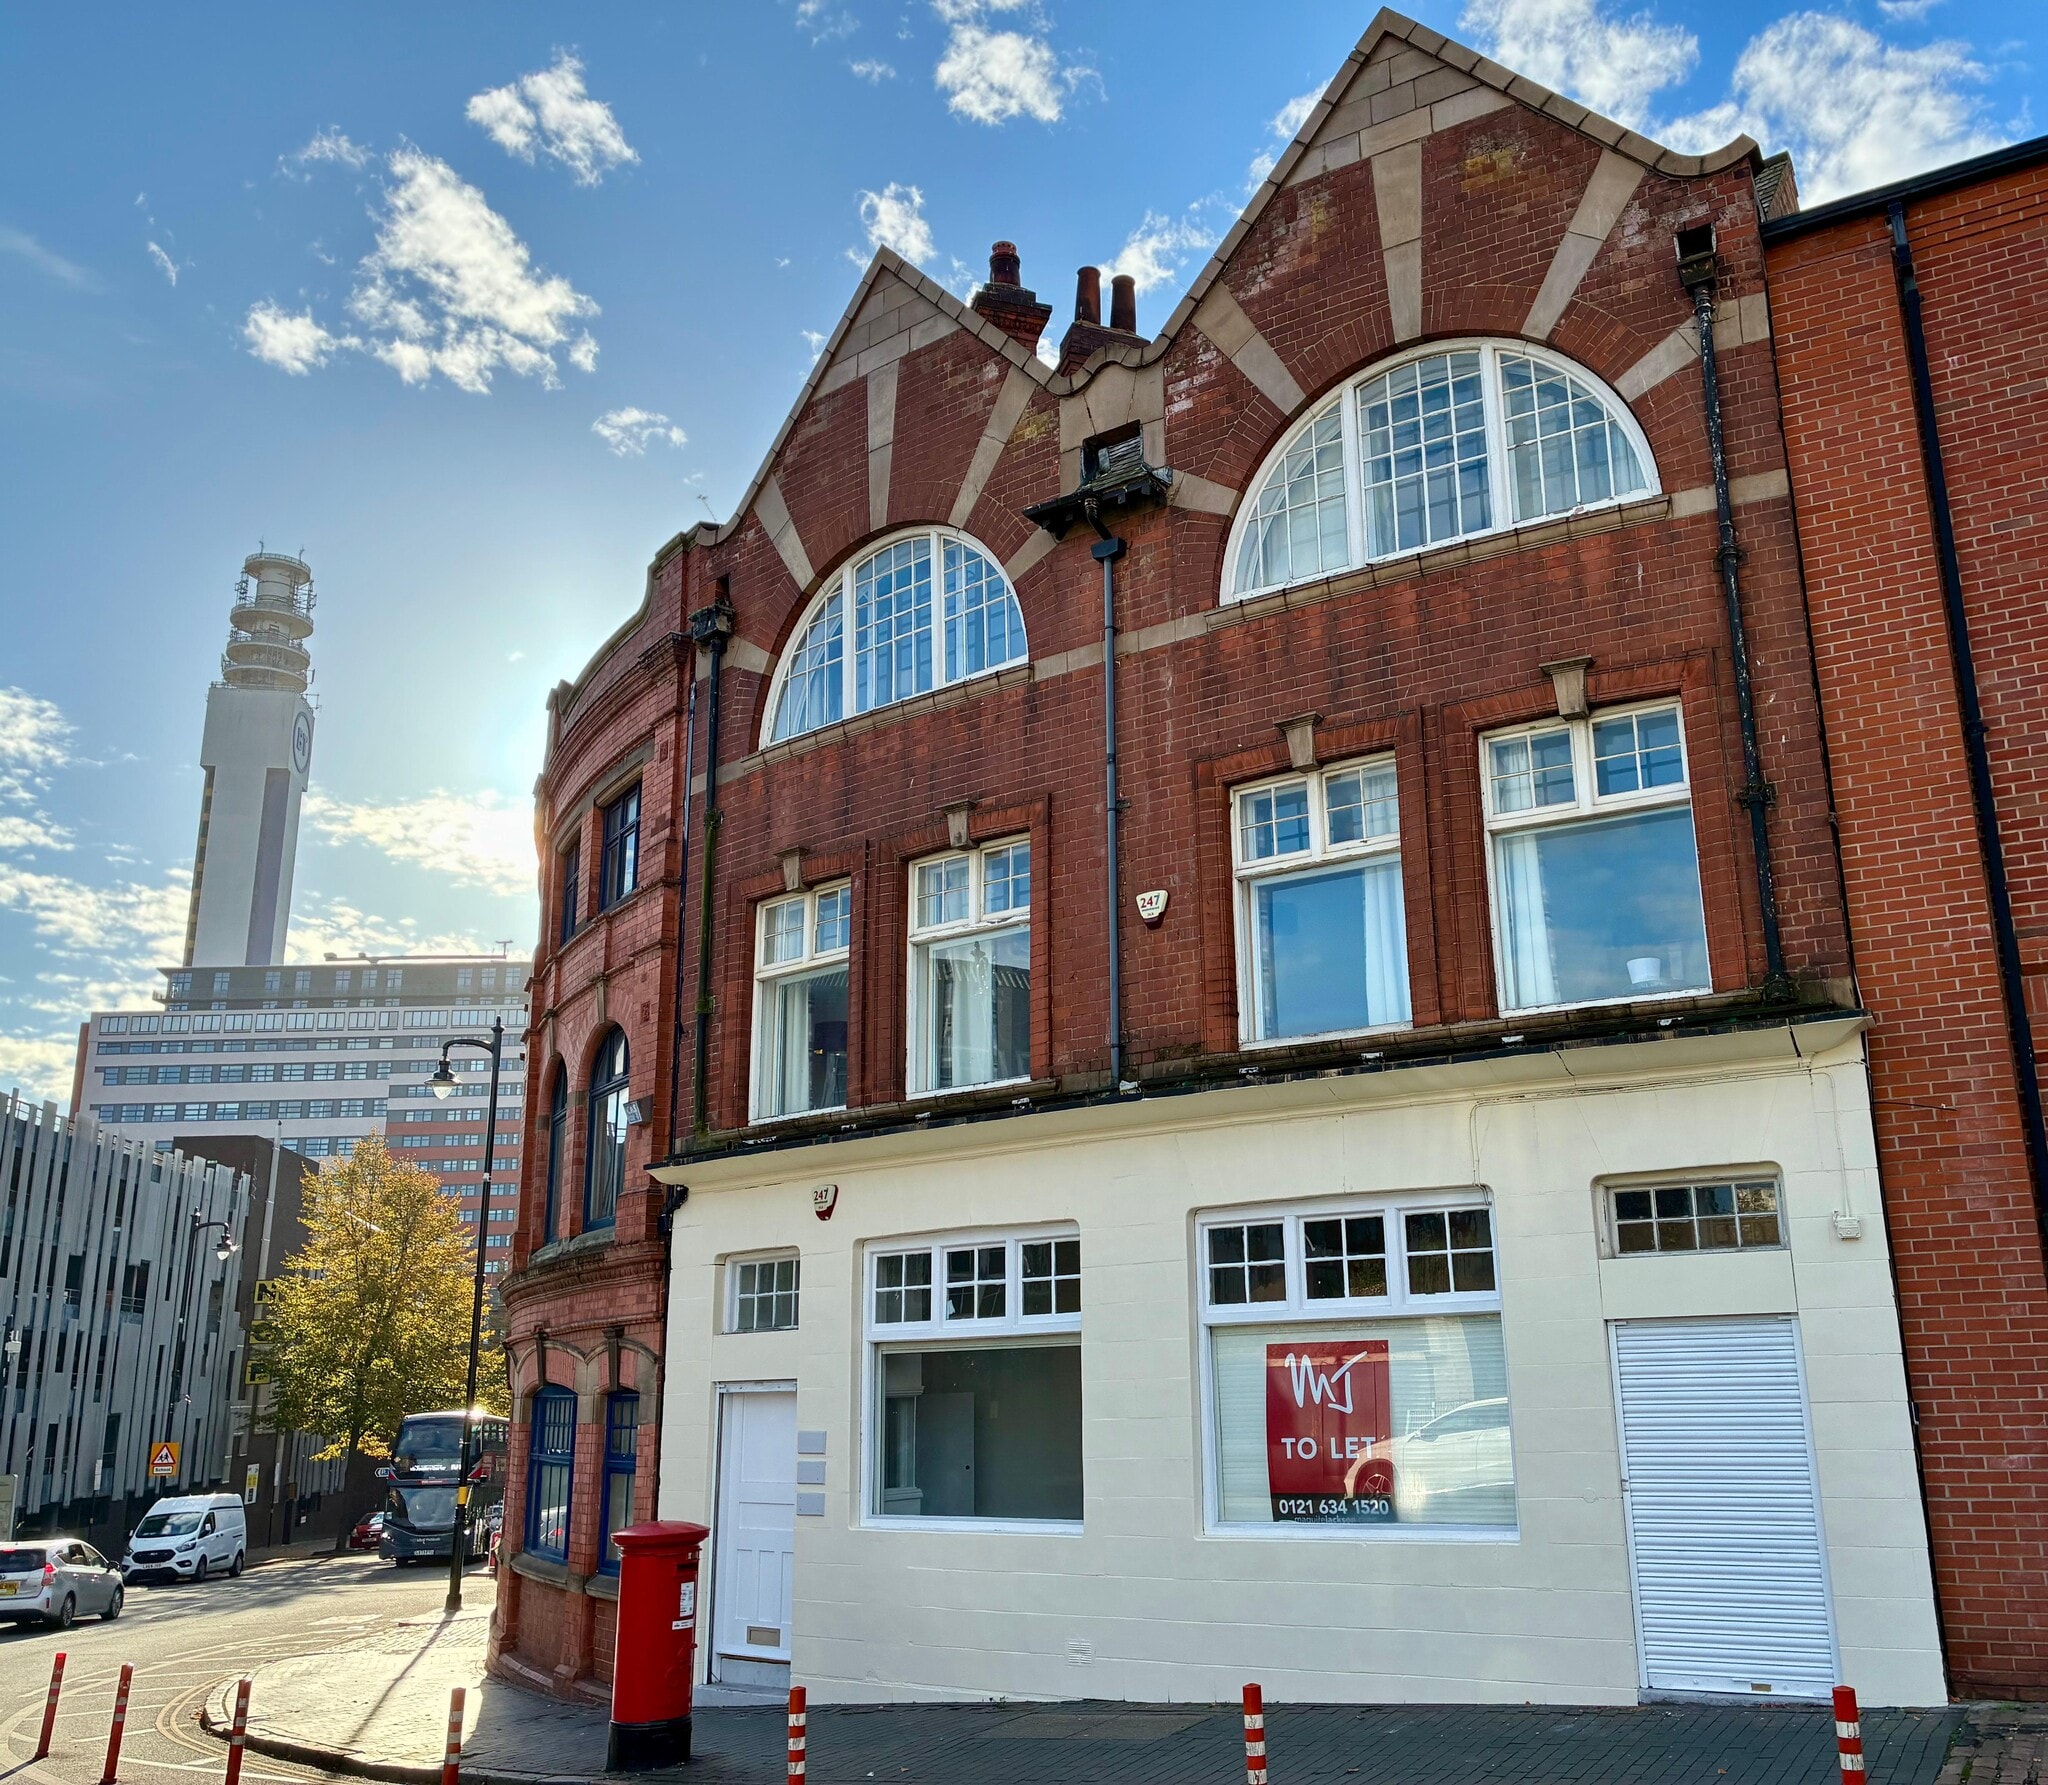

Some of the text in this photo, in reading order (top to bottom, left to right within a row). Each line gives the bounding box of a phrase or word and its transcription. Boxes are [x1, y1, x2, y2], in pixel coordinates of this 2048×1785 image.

[1140, 894, 1160, 908] 247
[813, 1187, 828, 1201] 247
[1281, 1436, 1376, 1460] TO LET
[1278, 1499, 1389, 1515] 0121 634 1520
